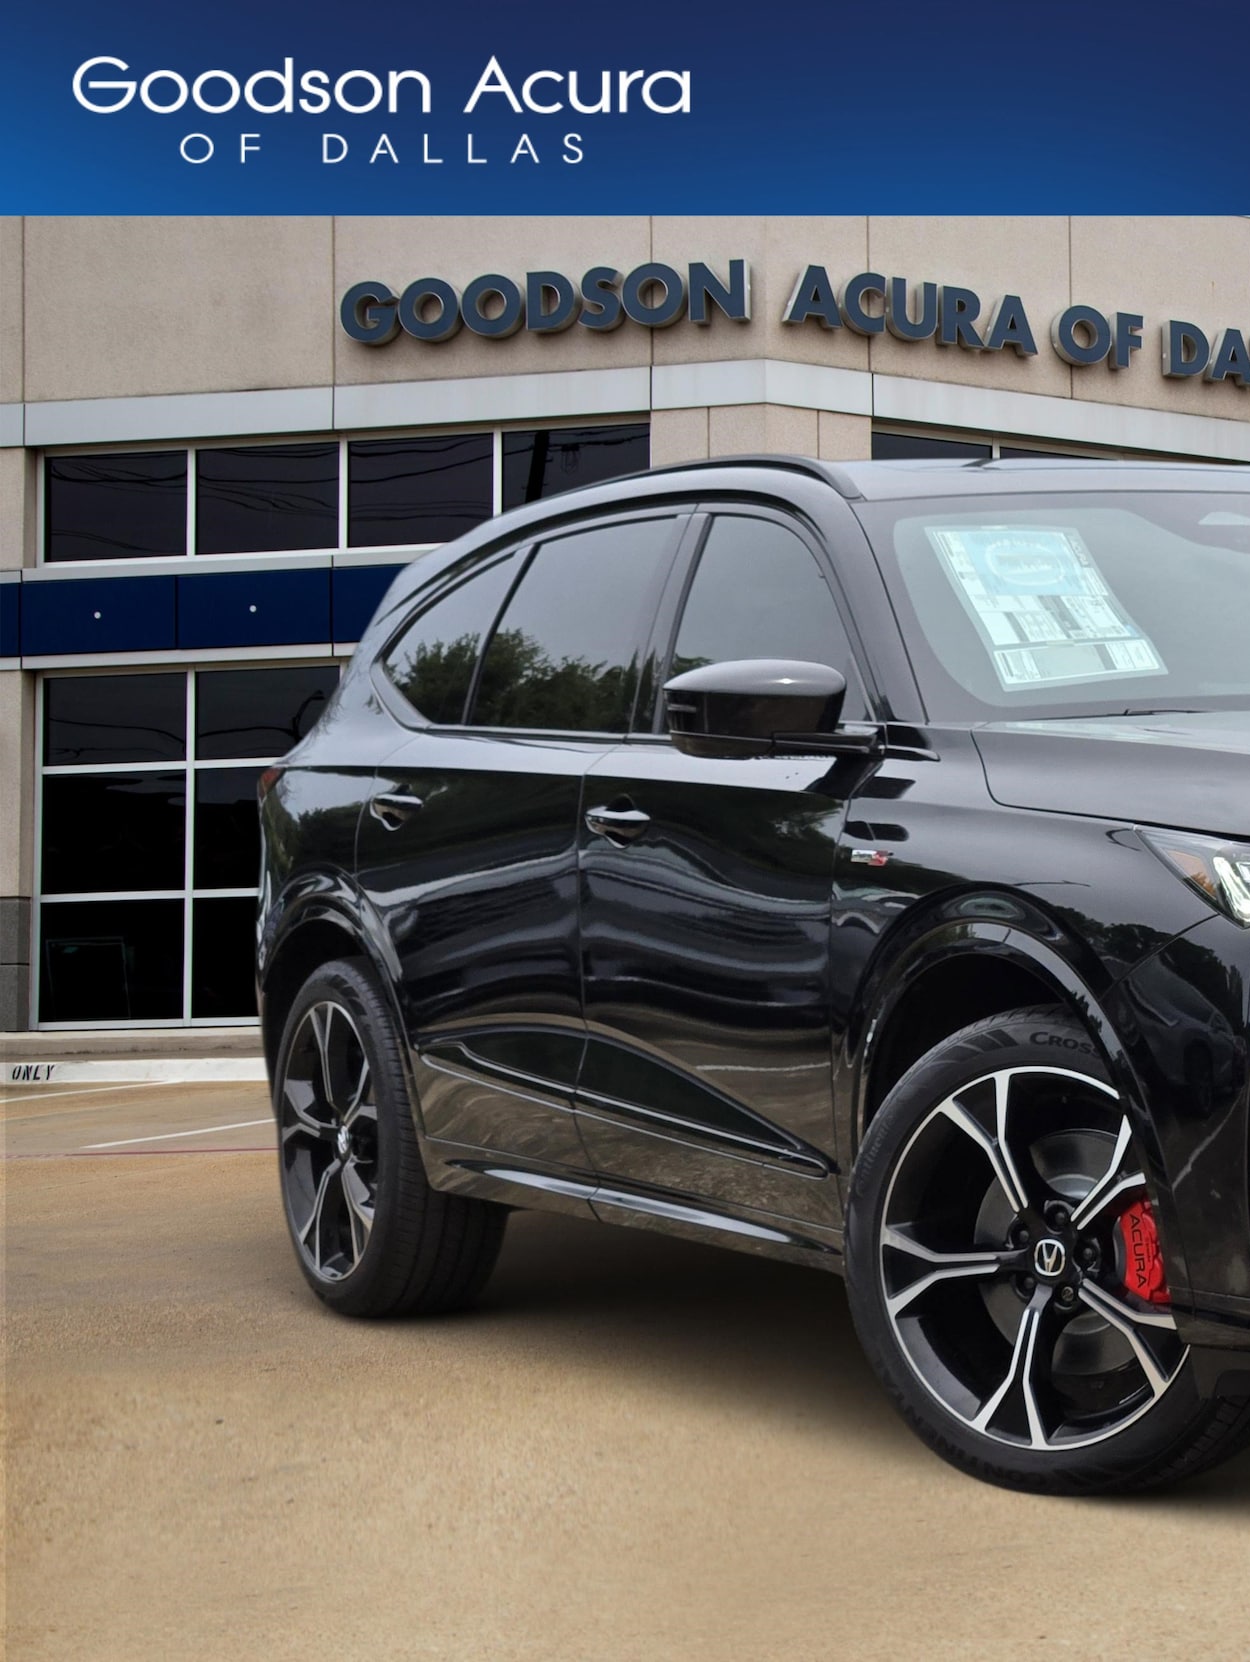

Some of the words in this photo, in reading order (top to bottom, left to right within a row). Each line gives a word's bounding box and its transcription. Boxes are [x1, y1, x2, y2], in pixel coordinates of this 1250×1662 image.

[340, 258, 752, 347] GOODSON
[780, 263, 1038, 357] ACURA
[1053, 304, 1144, 370] OF
[12, 1064, 55, 1081] ONLY
[1129, 1213, 1148, 1289] ACURA
